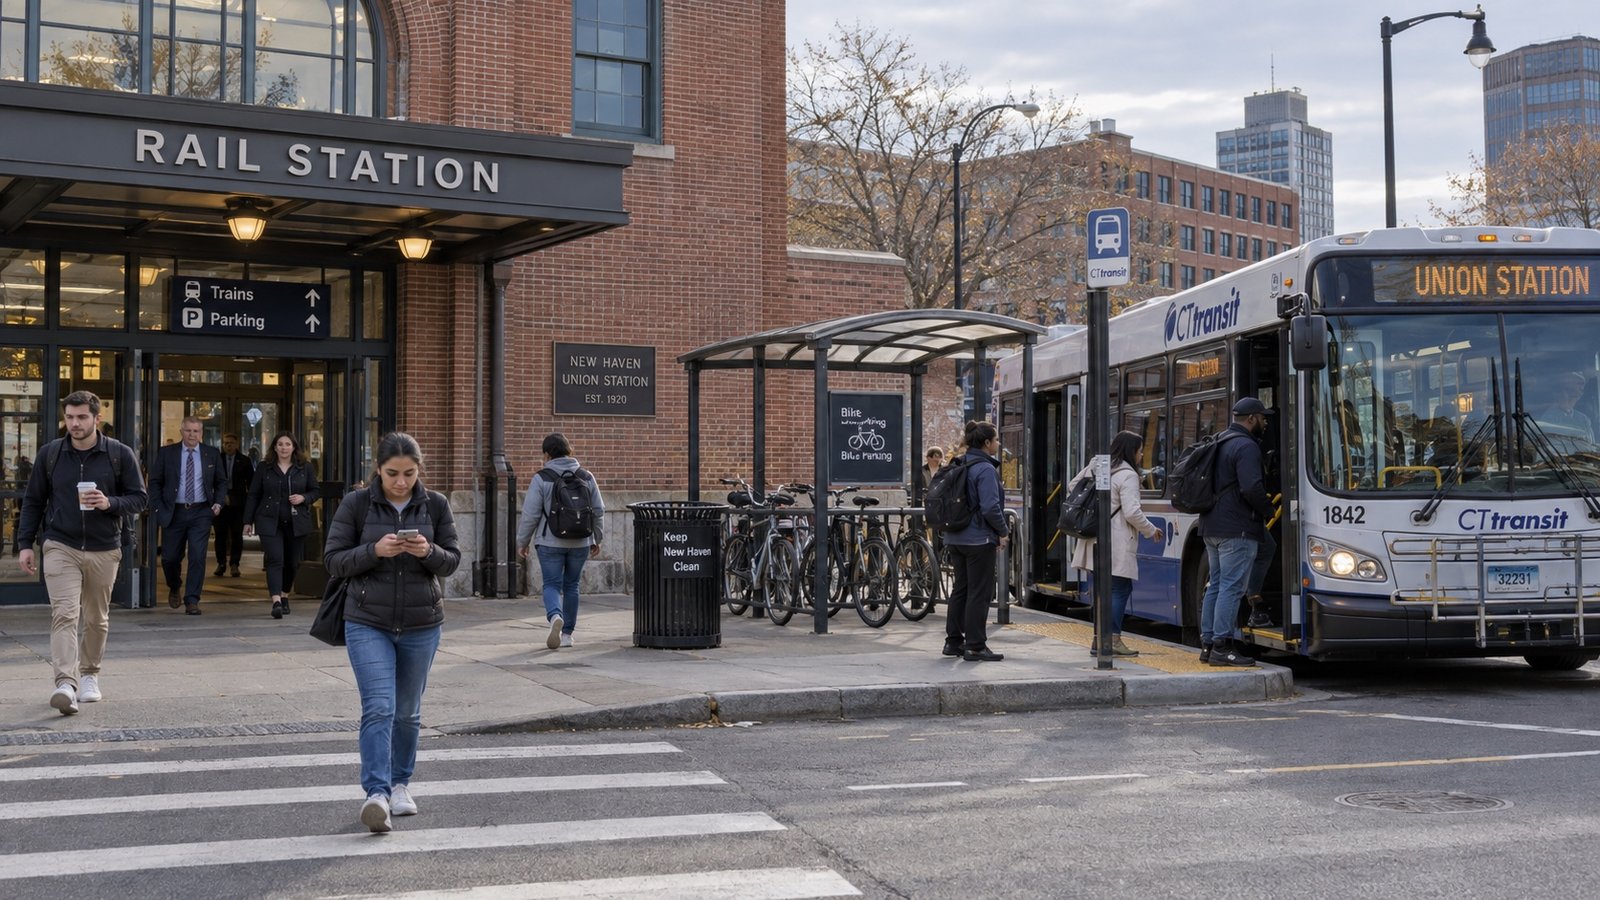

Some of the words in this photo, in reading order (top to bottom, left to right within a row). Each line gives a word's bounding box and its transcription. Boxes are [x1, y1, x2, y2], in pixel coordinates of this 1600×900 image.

[136, 128, 261, 173] RAIL
[287, 143, 499, 193] STATION
[1090, 266, 1127, 278] CTtransit
[1415, 266, 1487, 295] UNION
[1496, 266, 1589, 295] STATION
[210, 285, 254, 301] Trains
[1177, 286, 1241, 341] CTtransit
[211, 312, 265, 330] Parking
[570, 355, 597, 367] NEW
[603, 357, 641, 369] HAVEN
[562, 373, 599, 386] UNION
[604, 375, 649, 387] STATION
[585, 394, 604, 404] EST.
[607, 395, 627, 405] 1920
[841, 407, 862, 418] Bike
[1323, 505, 1366, 524] 1842
[1458, 508, 1569, 531] CTtransit
[663, 531, 688, 544] Keep
[663, 546, 685, 557] New
[687, 546, 712, 557] Haven
[673, 561, 700, 572] Clean
[1498, 572, 1531, 585] 32231
